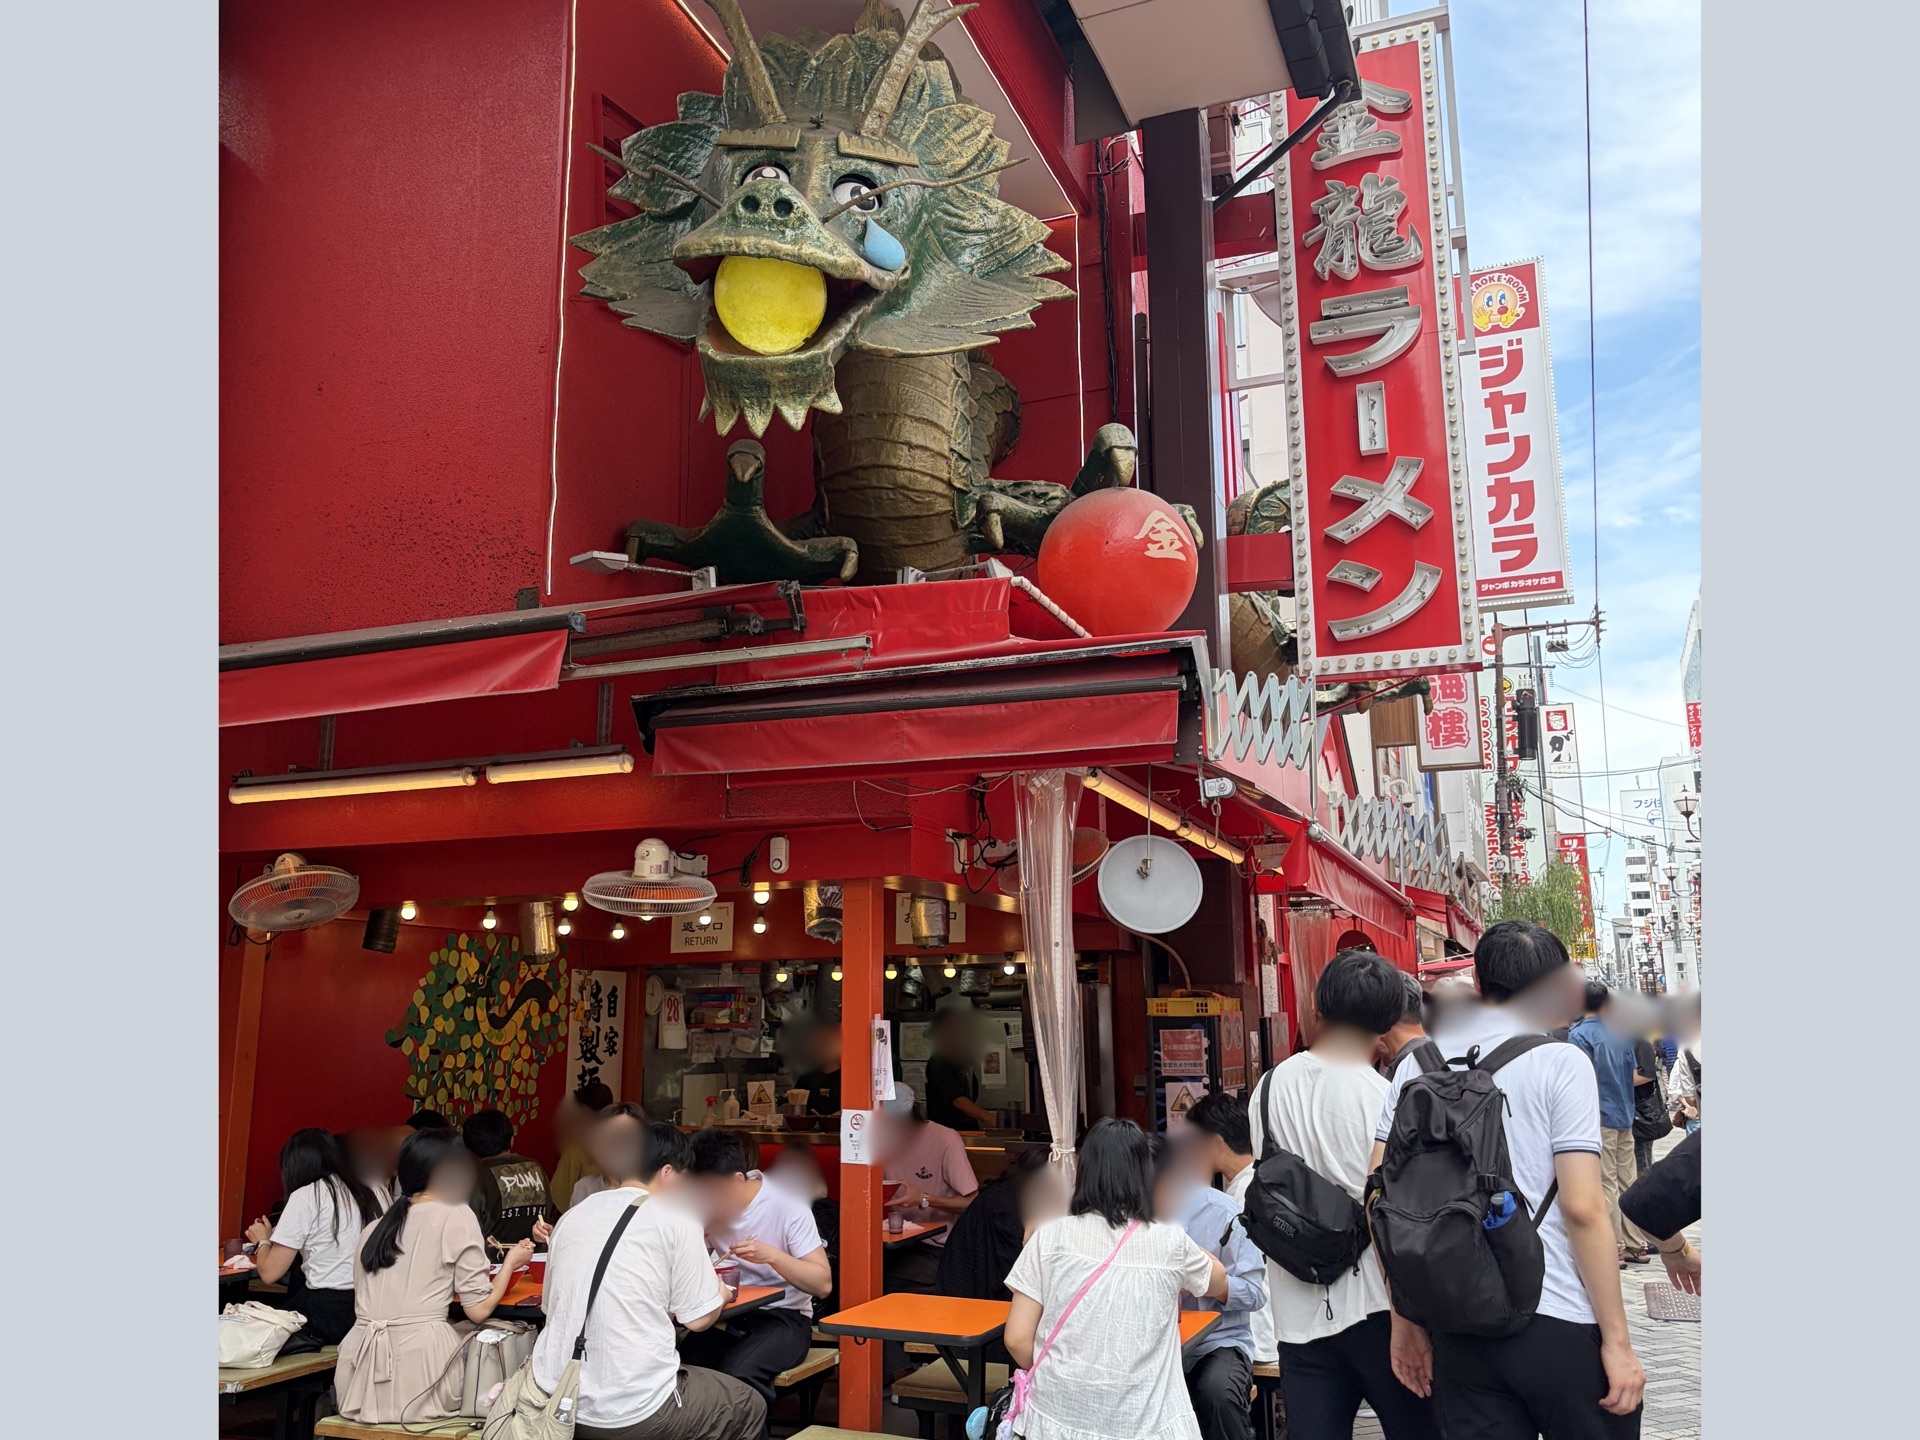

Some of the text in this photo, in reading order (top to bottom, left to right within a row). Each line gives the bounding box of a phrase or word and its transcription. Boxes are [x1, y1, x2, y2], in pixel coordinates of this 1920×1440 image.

[1300, 79, 1443, 642] 金龍ラーメン
[1479, 338, 1538, 573] ジャンカラ
[1134, 510, 1191, 561] 金
[684, 936, 718, 946] RETURN
[603, 984, 619, 1057] 自家
[667, 997, 680, 1022] 28
[500, 1171, 544, 1192] PUMA
[502, 1208, 520, 1219] EST.
